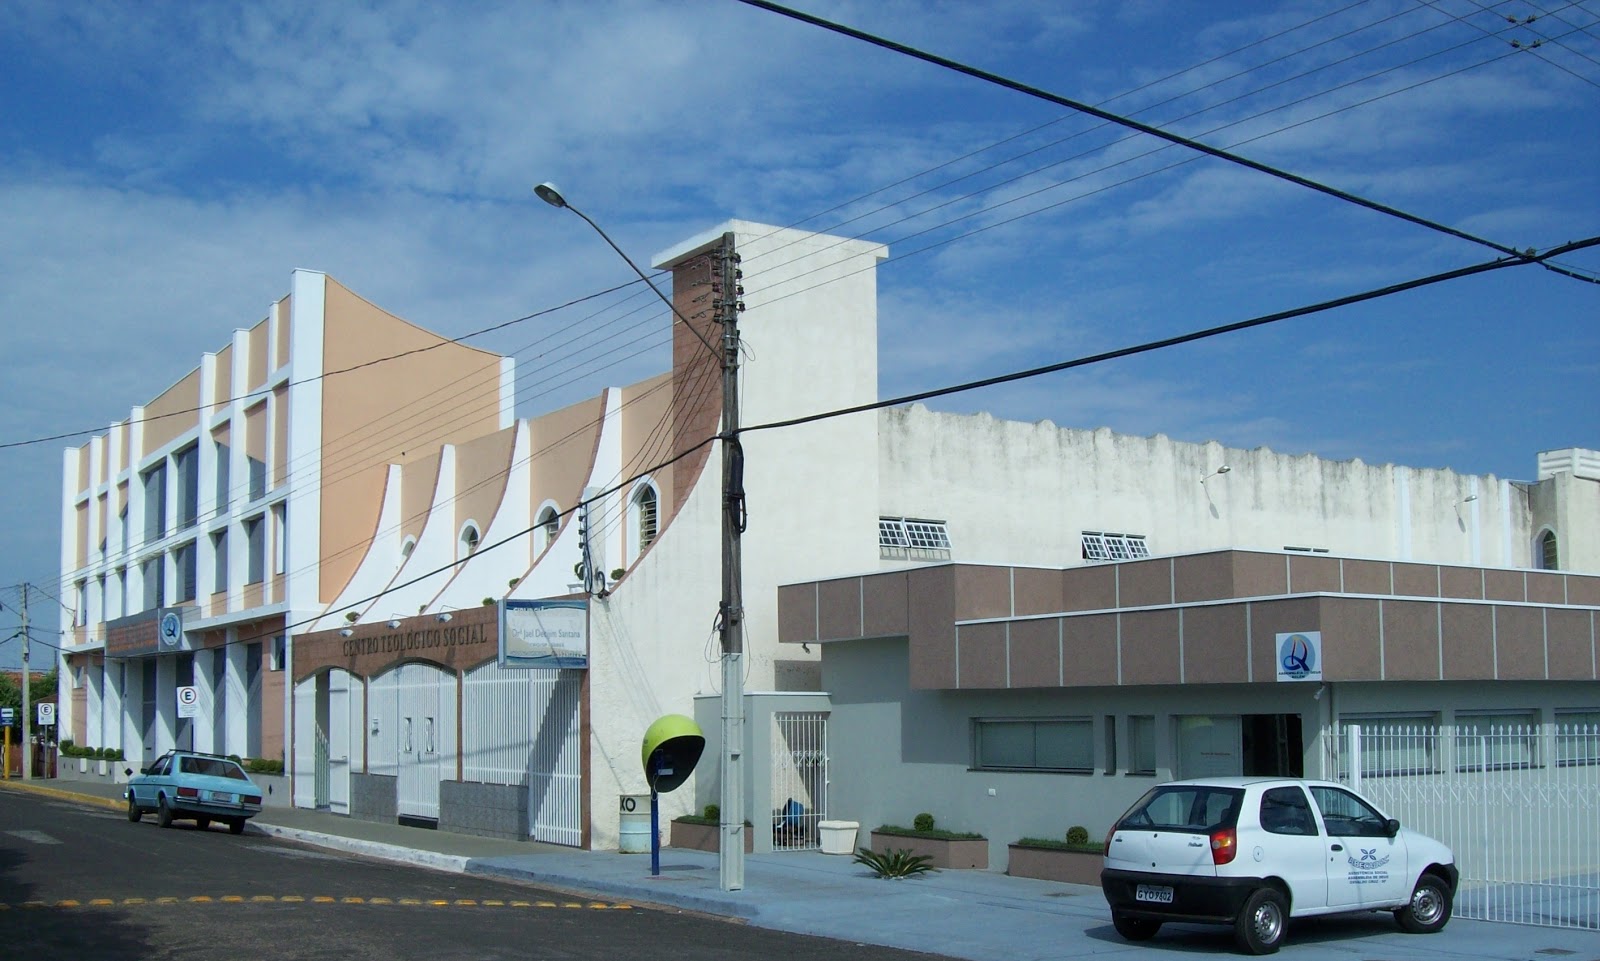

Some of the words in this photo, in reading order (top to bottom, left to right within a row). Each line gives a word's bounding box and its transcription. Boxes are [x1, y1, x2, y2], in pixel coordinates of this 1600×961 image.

[558, 628, 581, 638] Santana
[343, 637, 379, 656] CENTRO
[381, 628, 441, 653] TEOLÓGICO
[443, 624, 488, 646] SOCIAL
[185, 691, 192, 700] E
